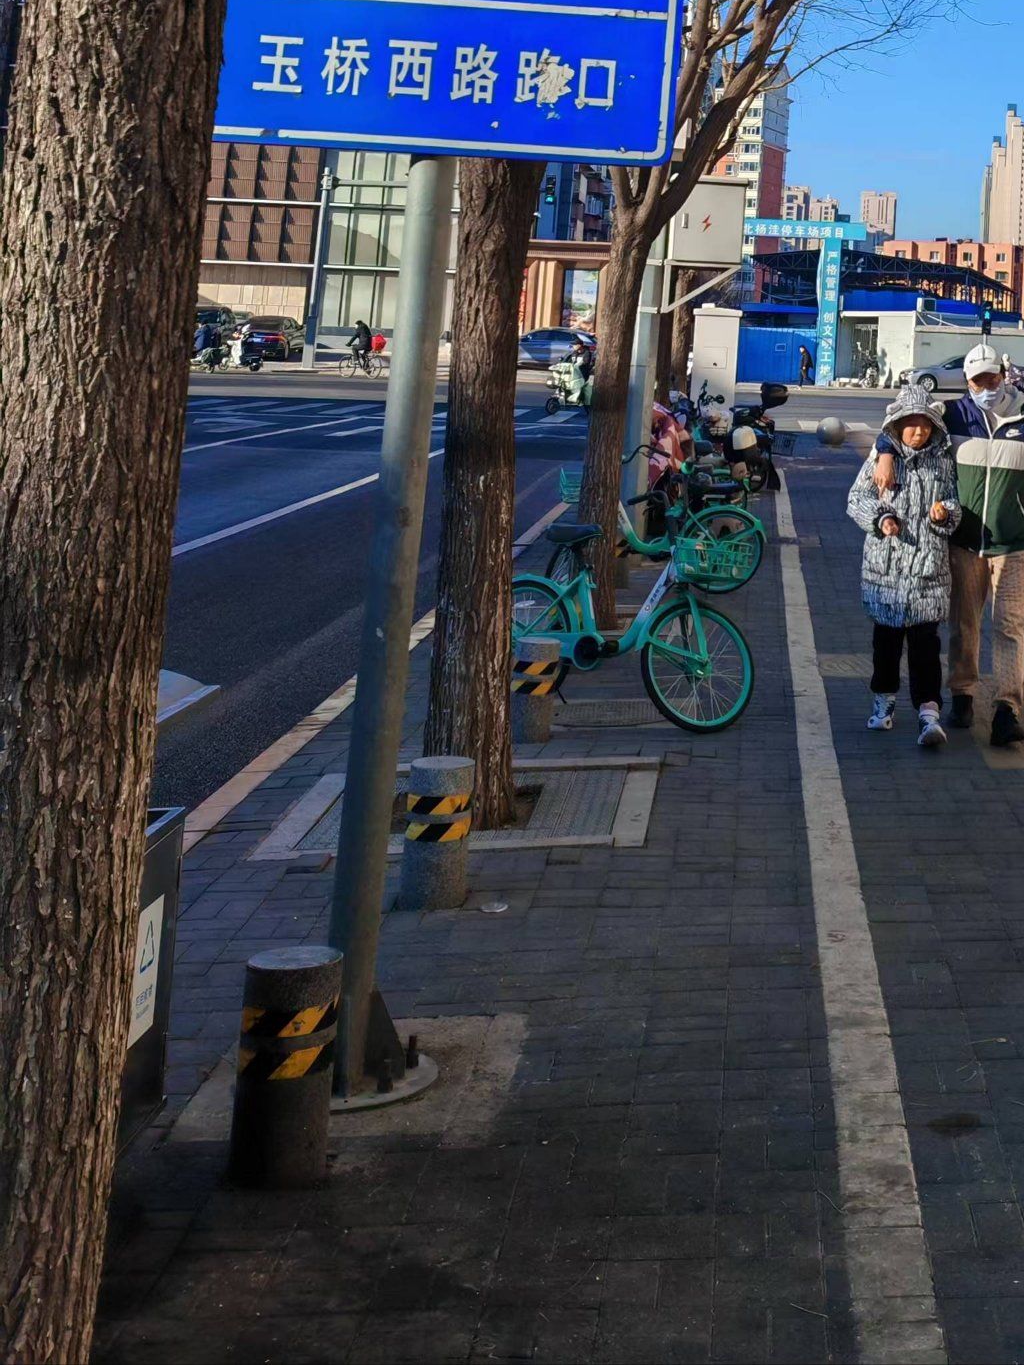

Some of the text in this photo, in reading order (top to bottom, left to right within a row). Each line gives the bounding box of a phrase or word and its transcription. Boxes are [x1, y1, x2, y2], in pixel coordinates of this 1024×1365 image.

[252, 34, 618, 110] 玉桥西路路口
